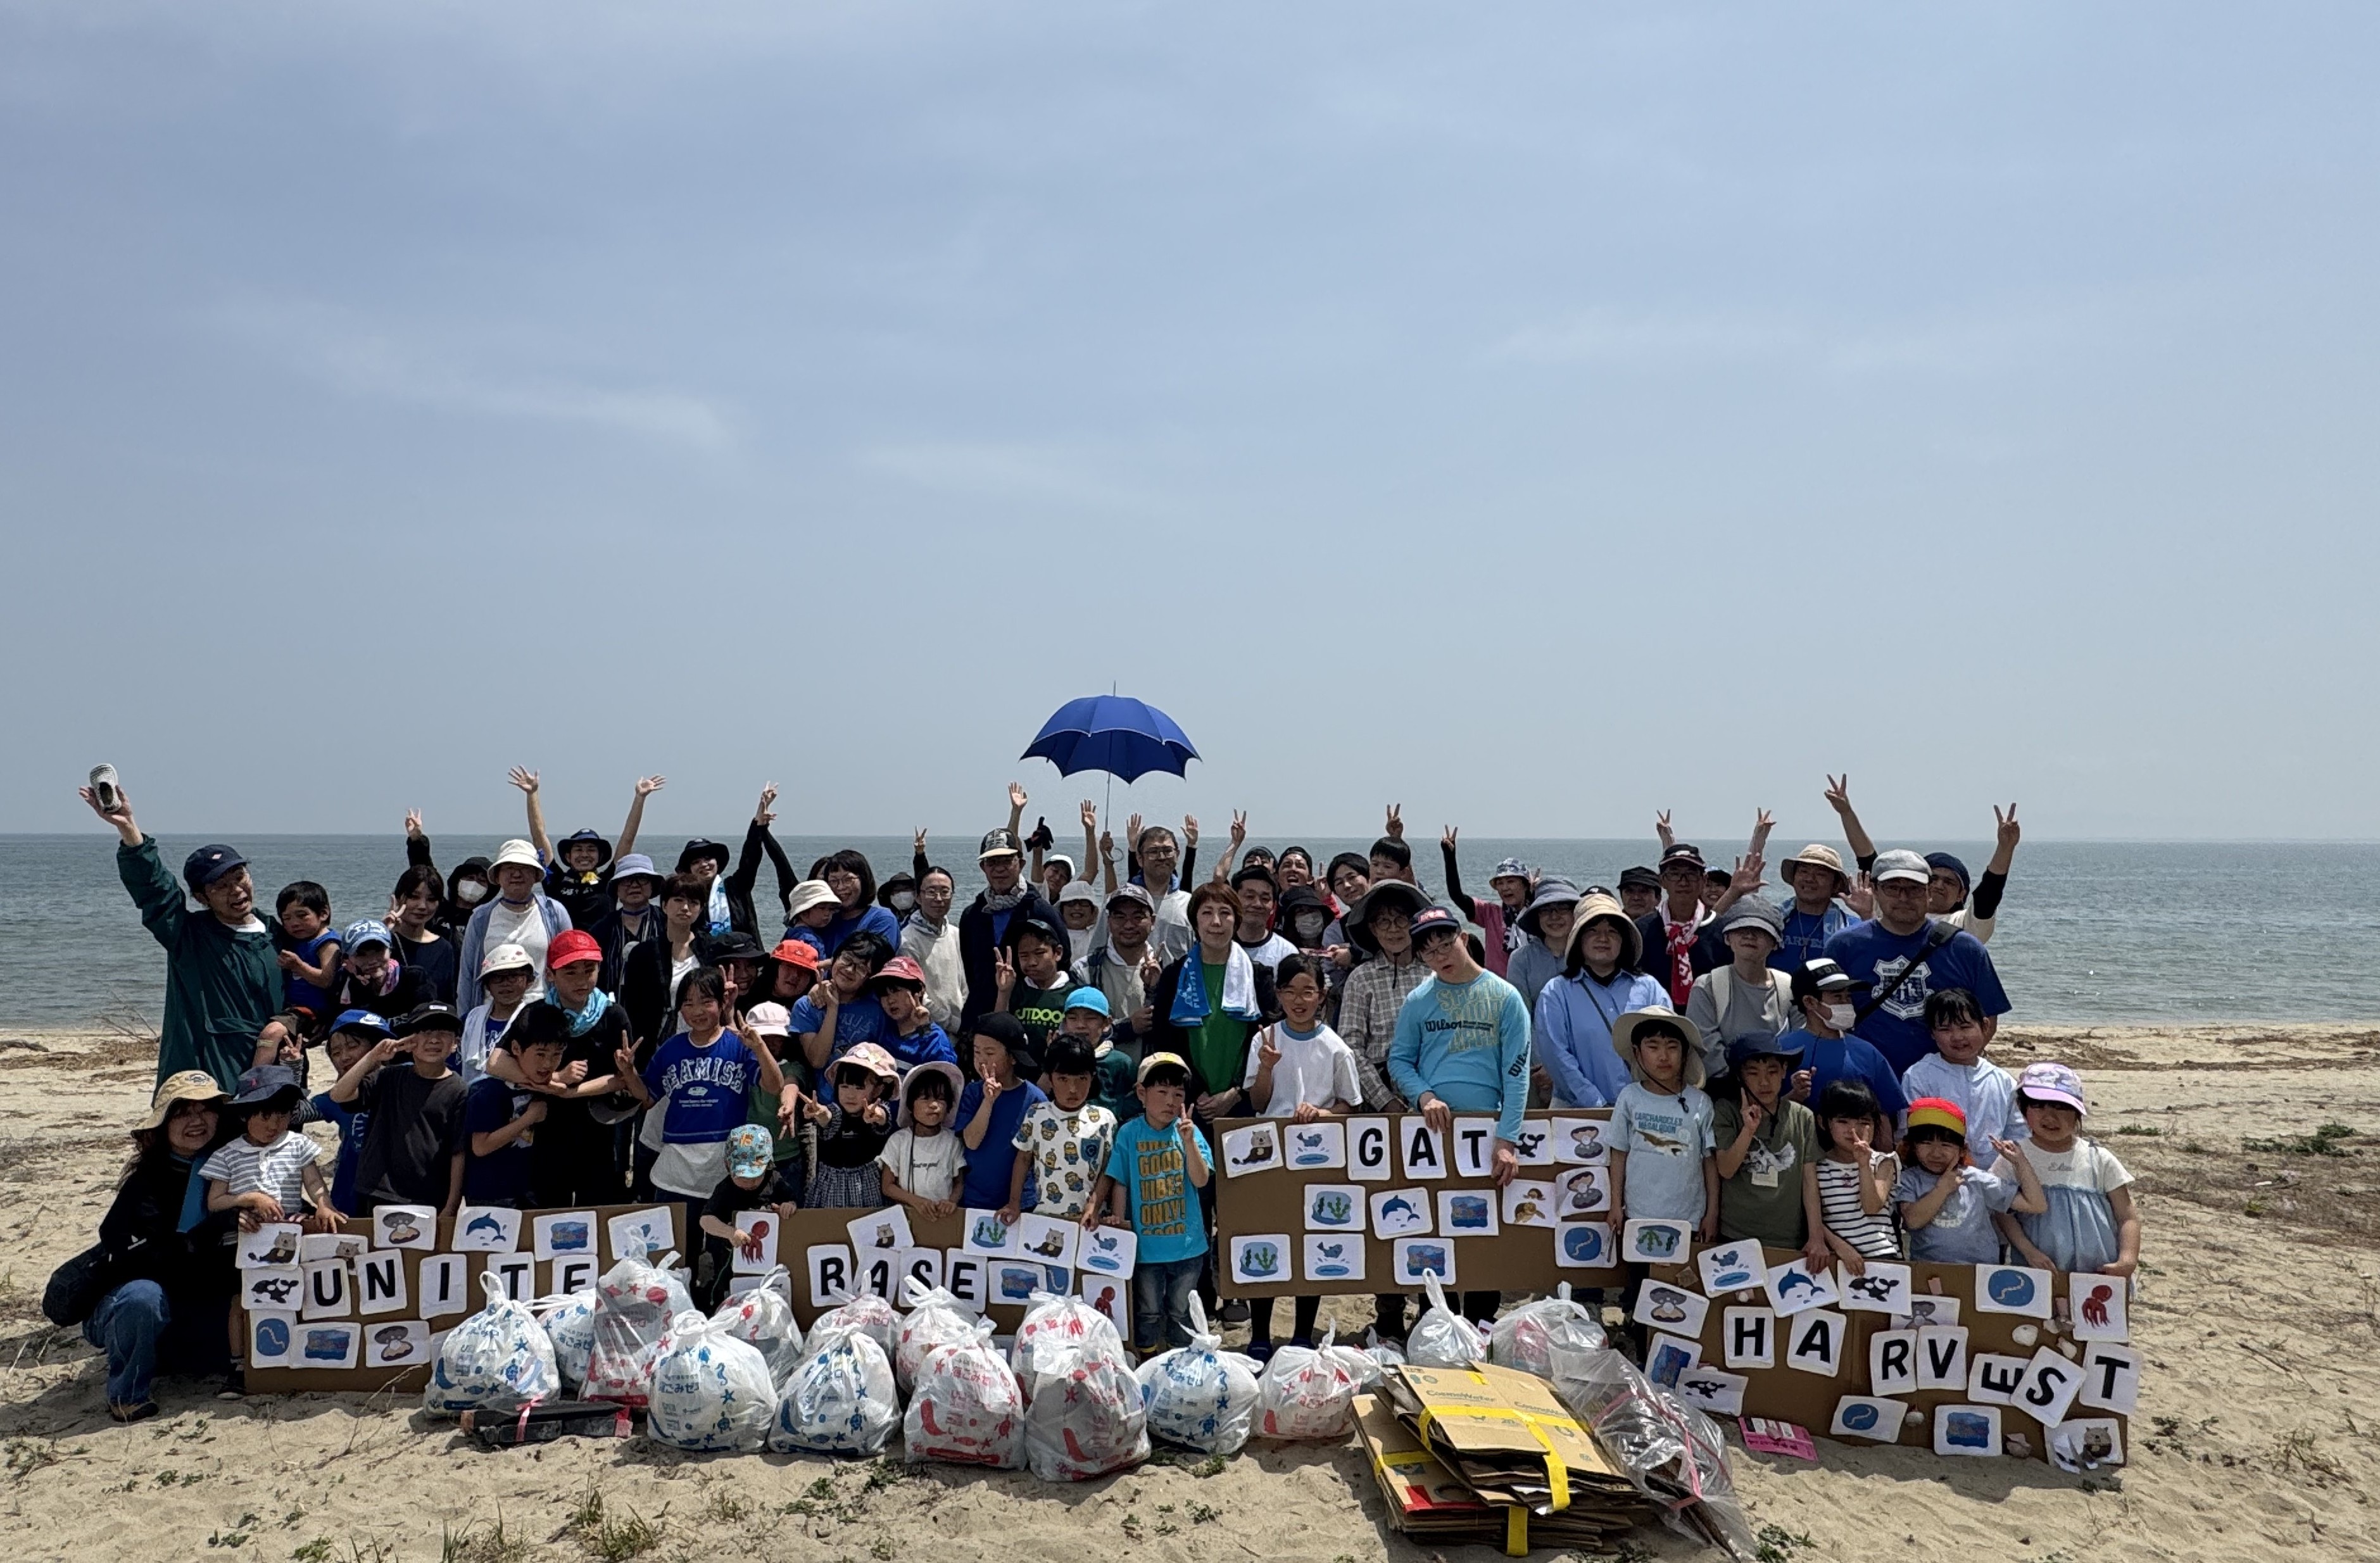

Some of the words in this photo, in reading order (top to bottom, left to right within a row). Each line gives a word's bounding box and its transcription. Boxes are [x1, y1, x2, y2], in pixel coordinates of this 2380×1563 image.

[1425, 1019, 1462, 1033] Wilson
[1138, 1148, 1183, 1177] GOOD
[1359, 1128, 1487, 1169] GAT
[1140, 1174, 1183, 1201] VIBES
